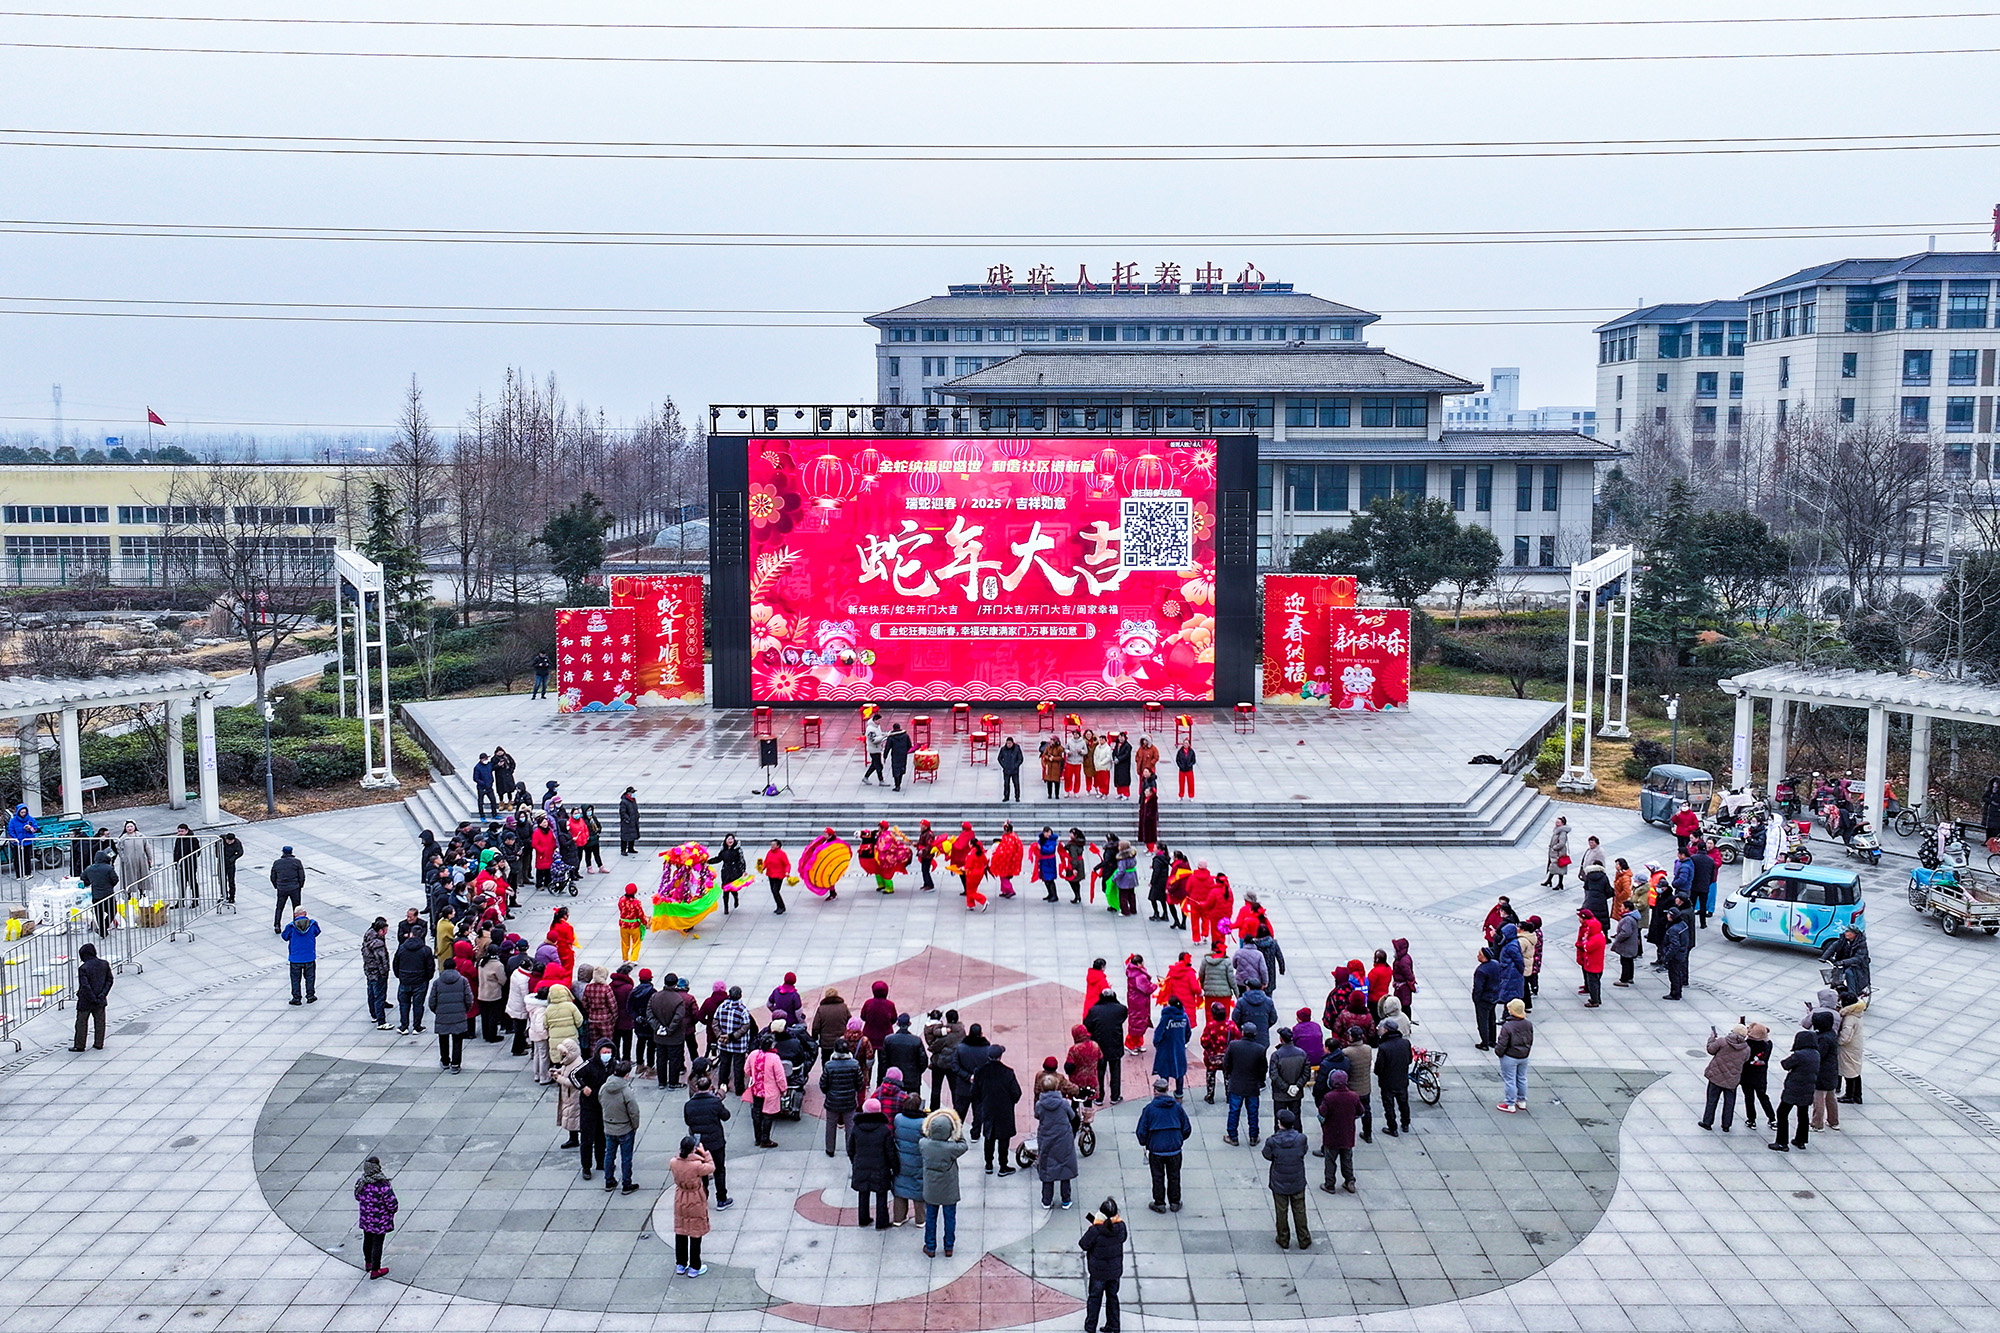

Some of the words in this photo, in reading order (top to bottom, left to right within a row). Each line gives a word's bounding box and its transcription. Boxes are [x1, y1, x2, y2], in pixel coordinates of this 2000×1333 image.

[986, 261, 1266, 292] 残疾人托养中心
[879, 460, 981, 473] 金蛇纳福迎盛世
[992, 460, 1095, 473] 和谐社区谱新篇
[905, 497, 957, 510] 瑞蛇迎春
[971, 499, 1001, 509] 2025
[1016, 497, 1066, 510] 吉祥如意
[856, 515, 1126, 601] 蛇年大吉
[848, 604, 958, 615] 新年快乐/蛇年开门大吉
[1355, 614, 1388, 629] 2025
[561, 634, 631, 647] 和谐共享
[1283, 592, 1310, 683] 迎春纳福
[1334, 624, 1406, 656] 新春快乐
[562, 652, 633, 665] 合作创新
[563, 669, 632, 683] 清廉生态
